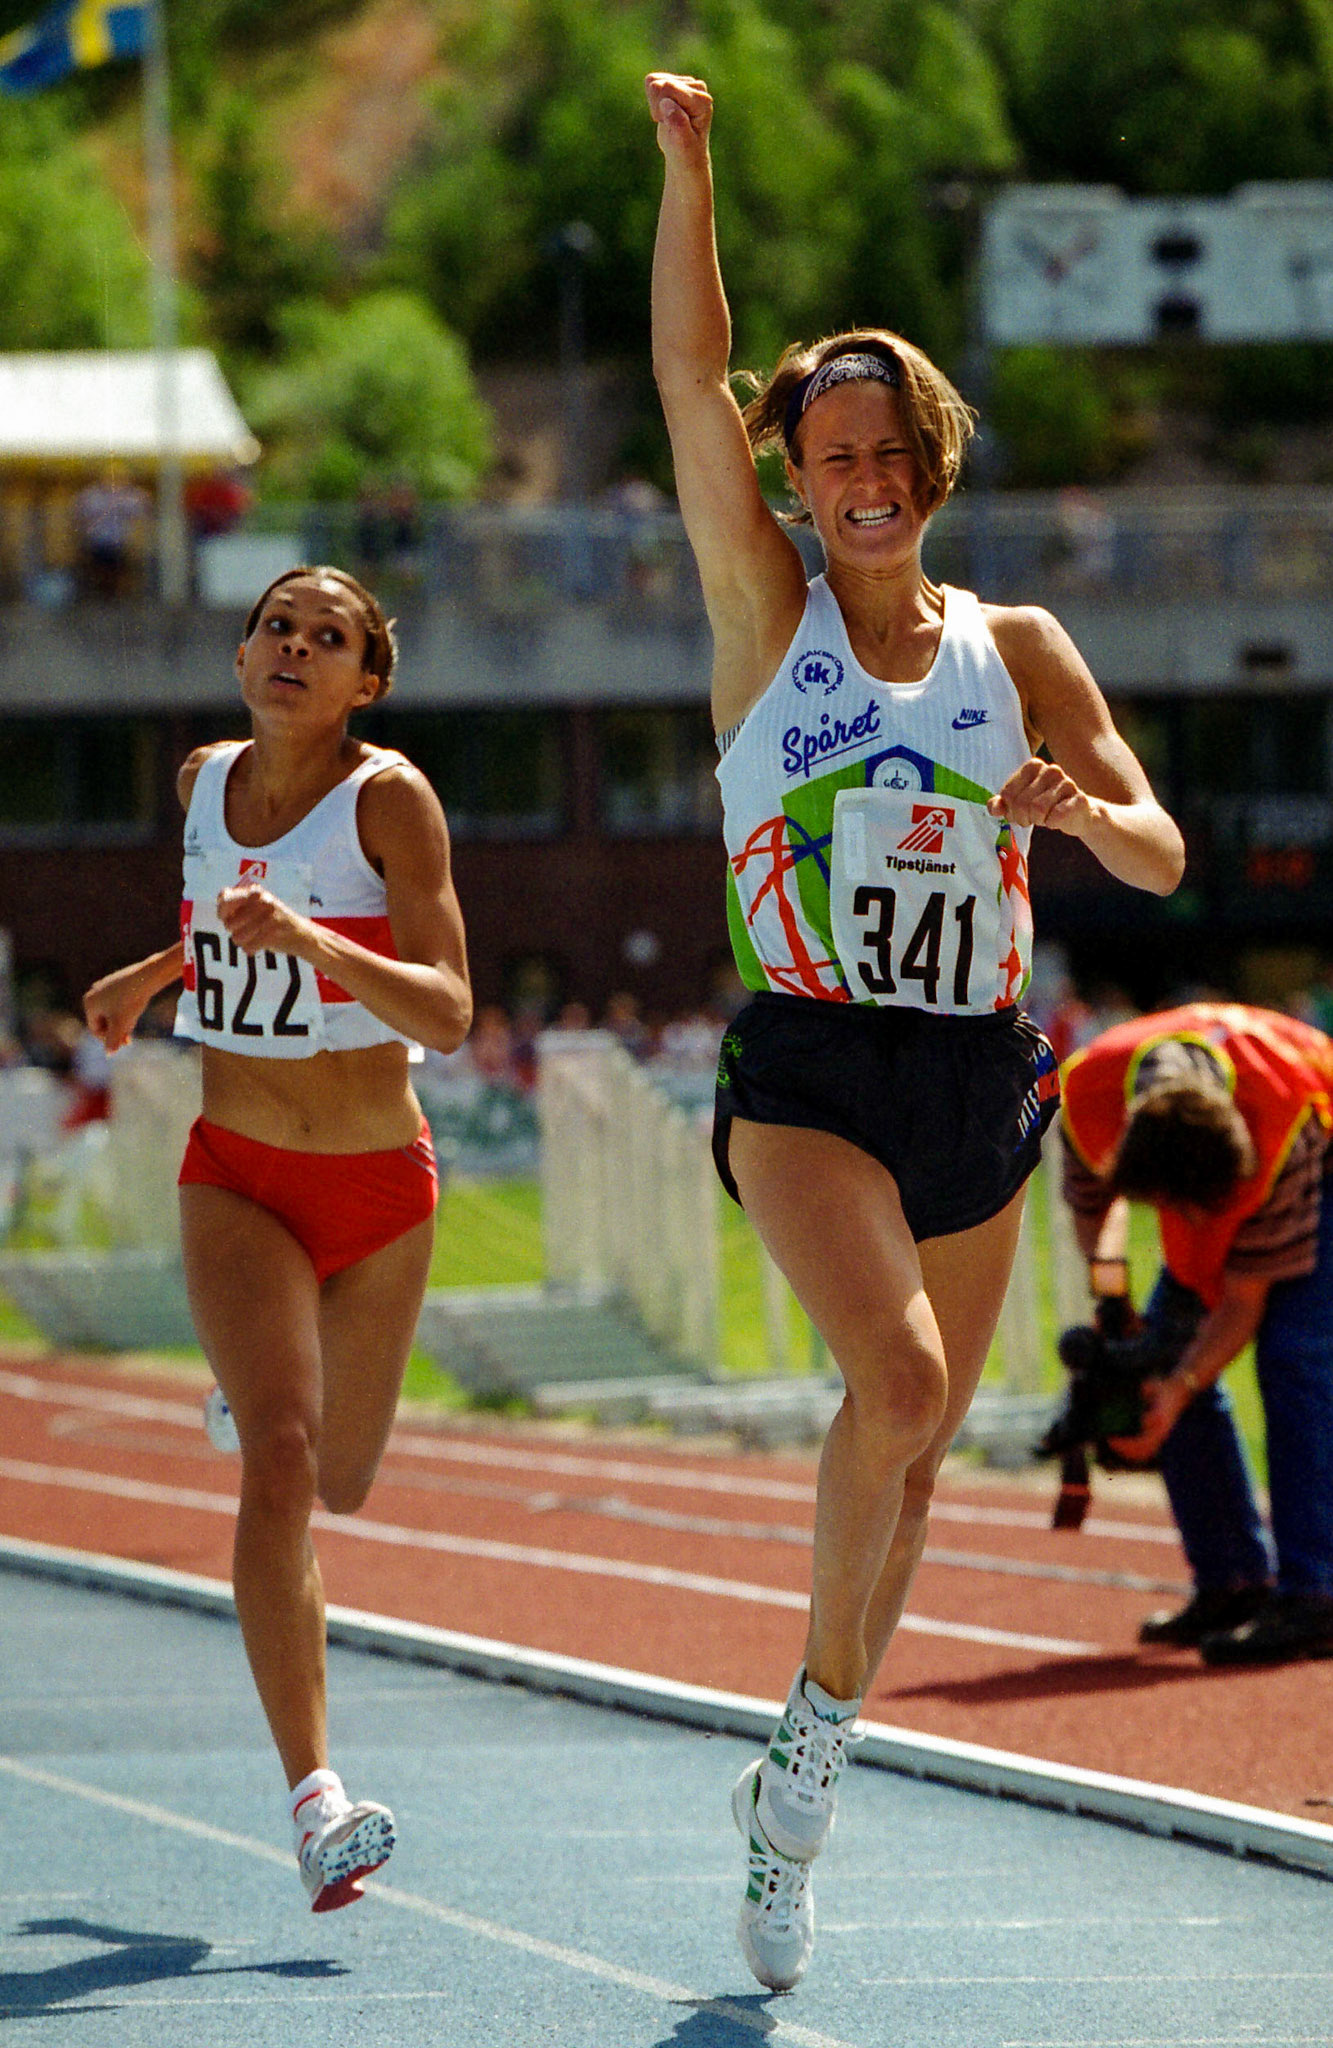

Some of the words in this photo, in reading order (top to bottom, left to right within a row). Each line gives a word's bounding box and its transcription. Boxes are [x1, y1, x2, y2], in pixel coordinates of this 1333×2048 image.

[804, 662, 831, 684] tk
[782, 699, 881, 778] Spåret
[959, 708, 988, 721] NIKE
[886, 855, 956, 874] Tipstjänst
[852, 885, 976, 1006] 341
[194, 931, 309, 1036] 622
